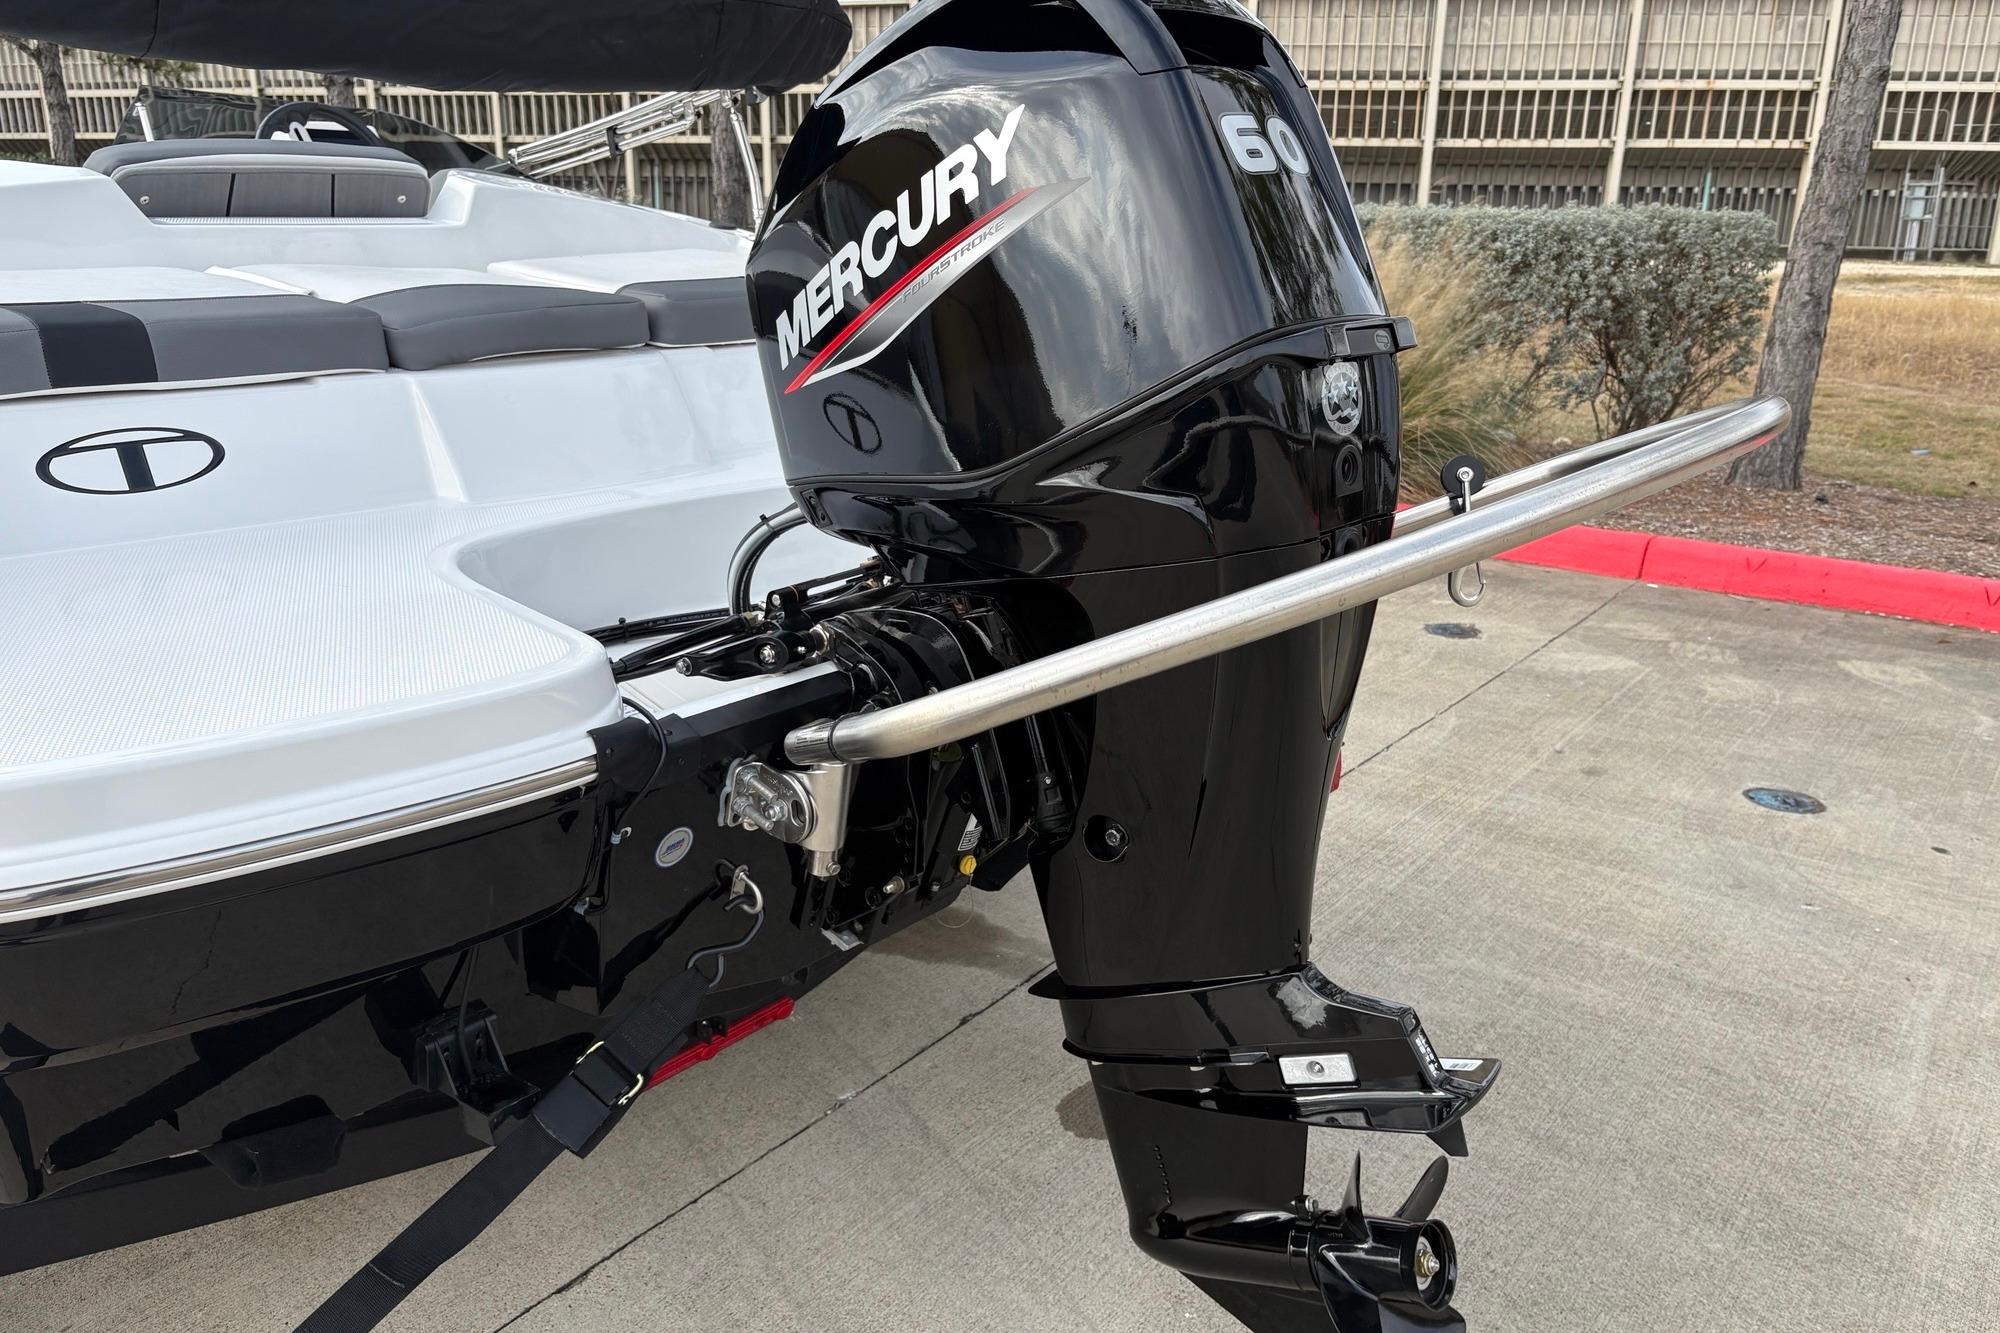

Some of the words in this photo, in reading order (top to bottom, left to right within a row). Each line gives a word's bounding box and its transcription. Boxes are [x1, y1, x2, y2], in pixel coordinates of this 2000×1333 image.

[1219, 112, 1311, 175] 60
[775, 104, 1025, 370] MERCURY
[902, 217, 1006, 303] FOURSTROKE
